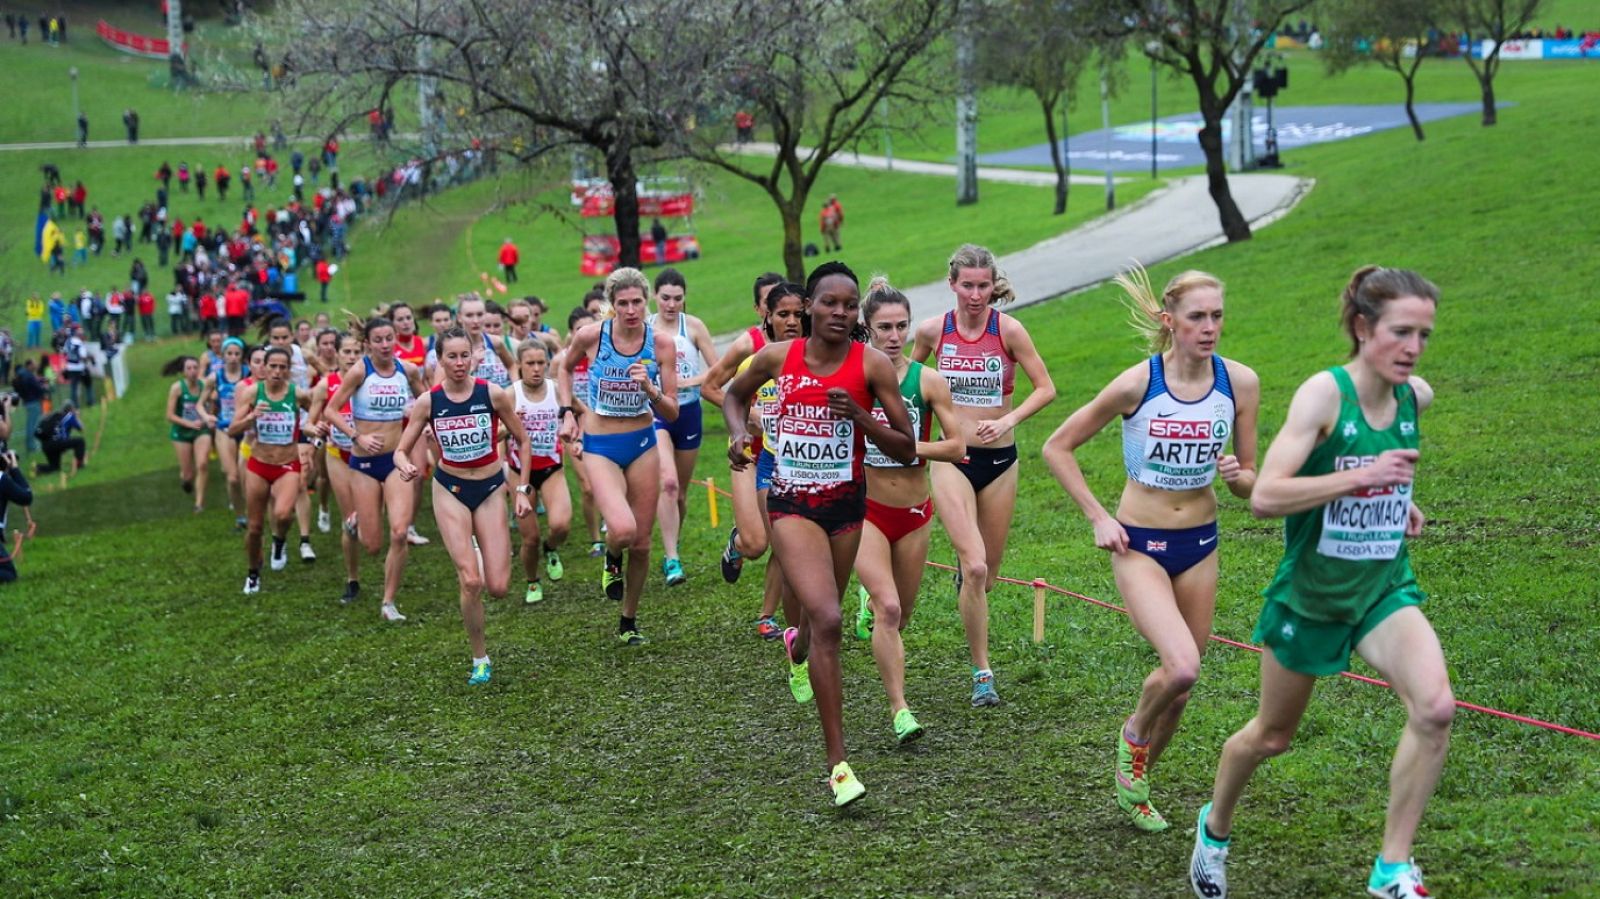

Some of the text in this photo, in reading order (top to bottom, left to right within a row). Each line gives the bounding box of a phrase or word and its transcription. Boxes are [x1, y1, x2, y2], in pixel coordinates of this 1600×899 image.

[941, 357, 984, 370] SPAR
[601, 381, 638, 391] SPAR
[945, 371, 1001, 389] TEWARTOVÁ
[371, 396, 406, 408] JUDD
[436, 417, 476, 430] SPAR
[783, 419, 833, 436] SPAR
[1151, 421, 1209, 437] SPAR
[782, 440, 849, 460] AKDAĞ
[1149, 442, 1222, 465] ARTER
[790, 470, 840, 480] LISBOA 2019
[1155, 475, 1188, 486] LISBOA
[1337, 544, 1397, 556] LISBOA 2019
